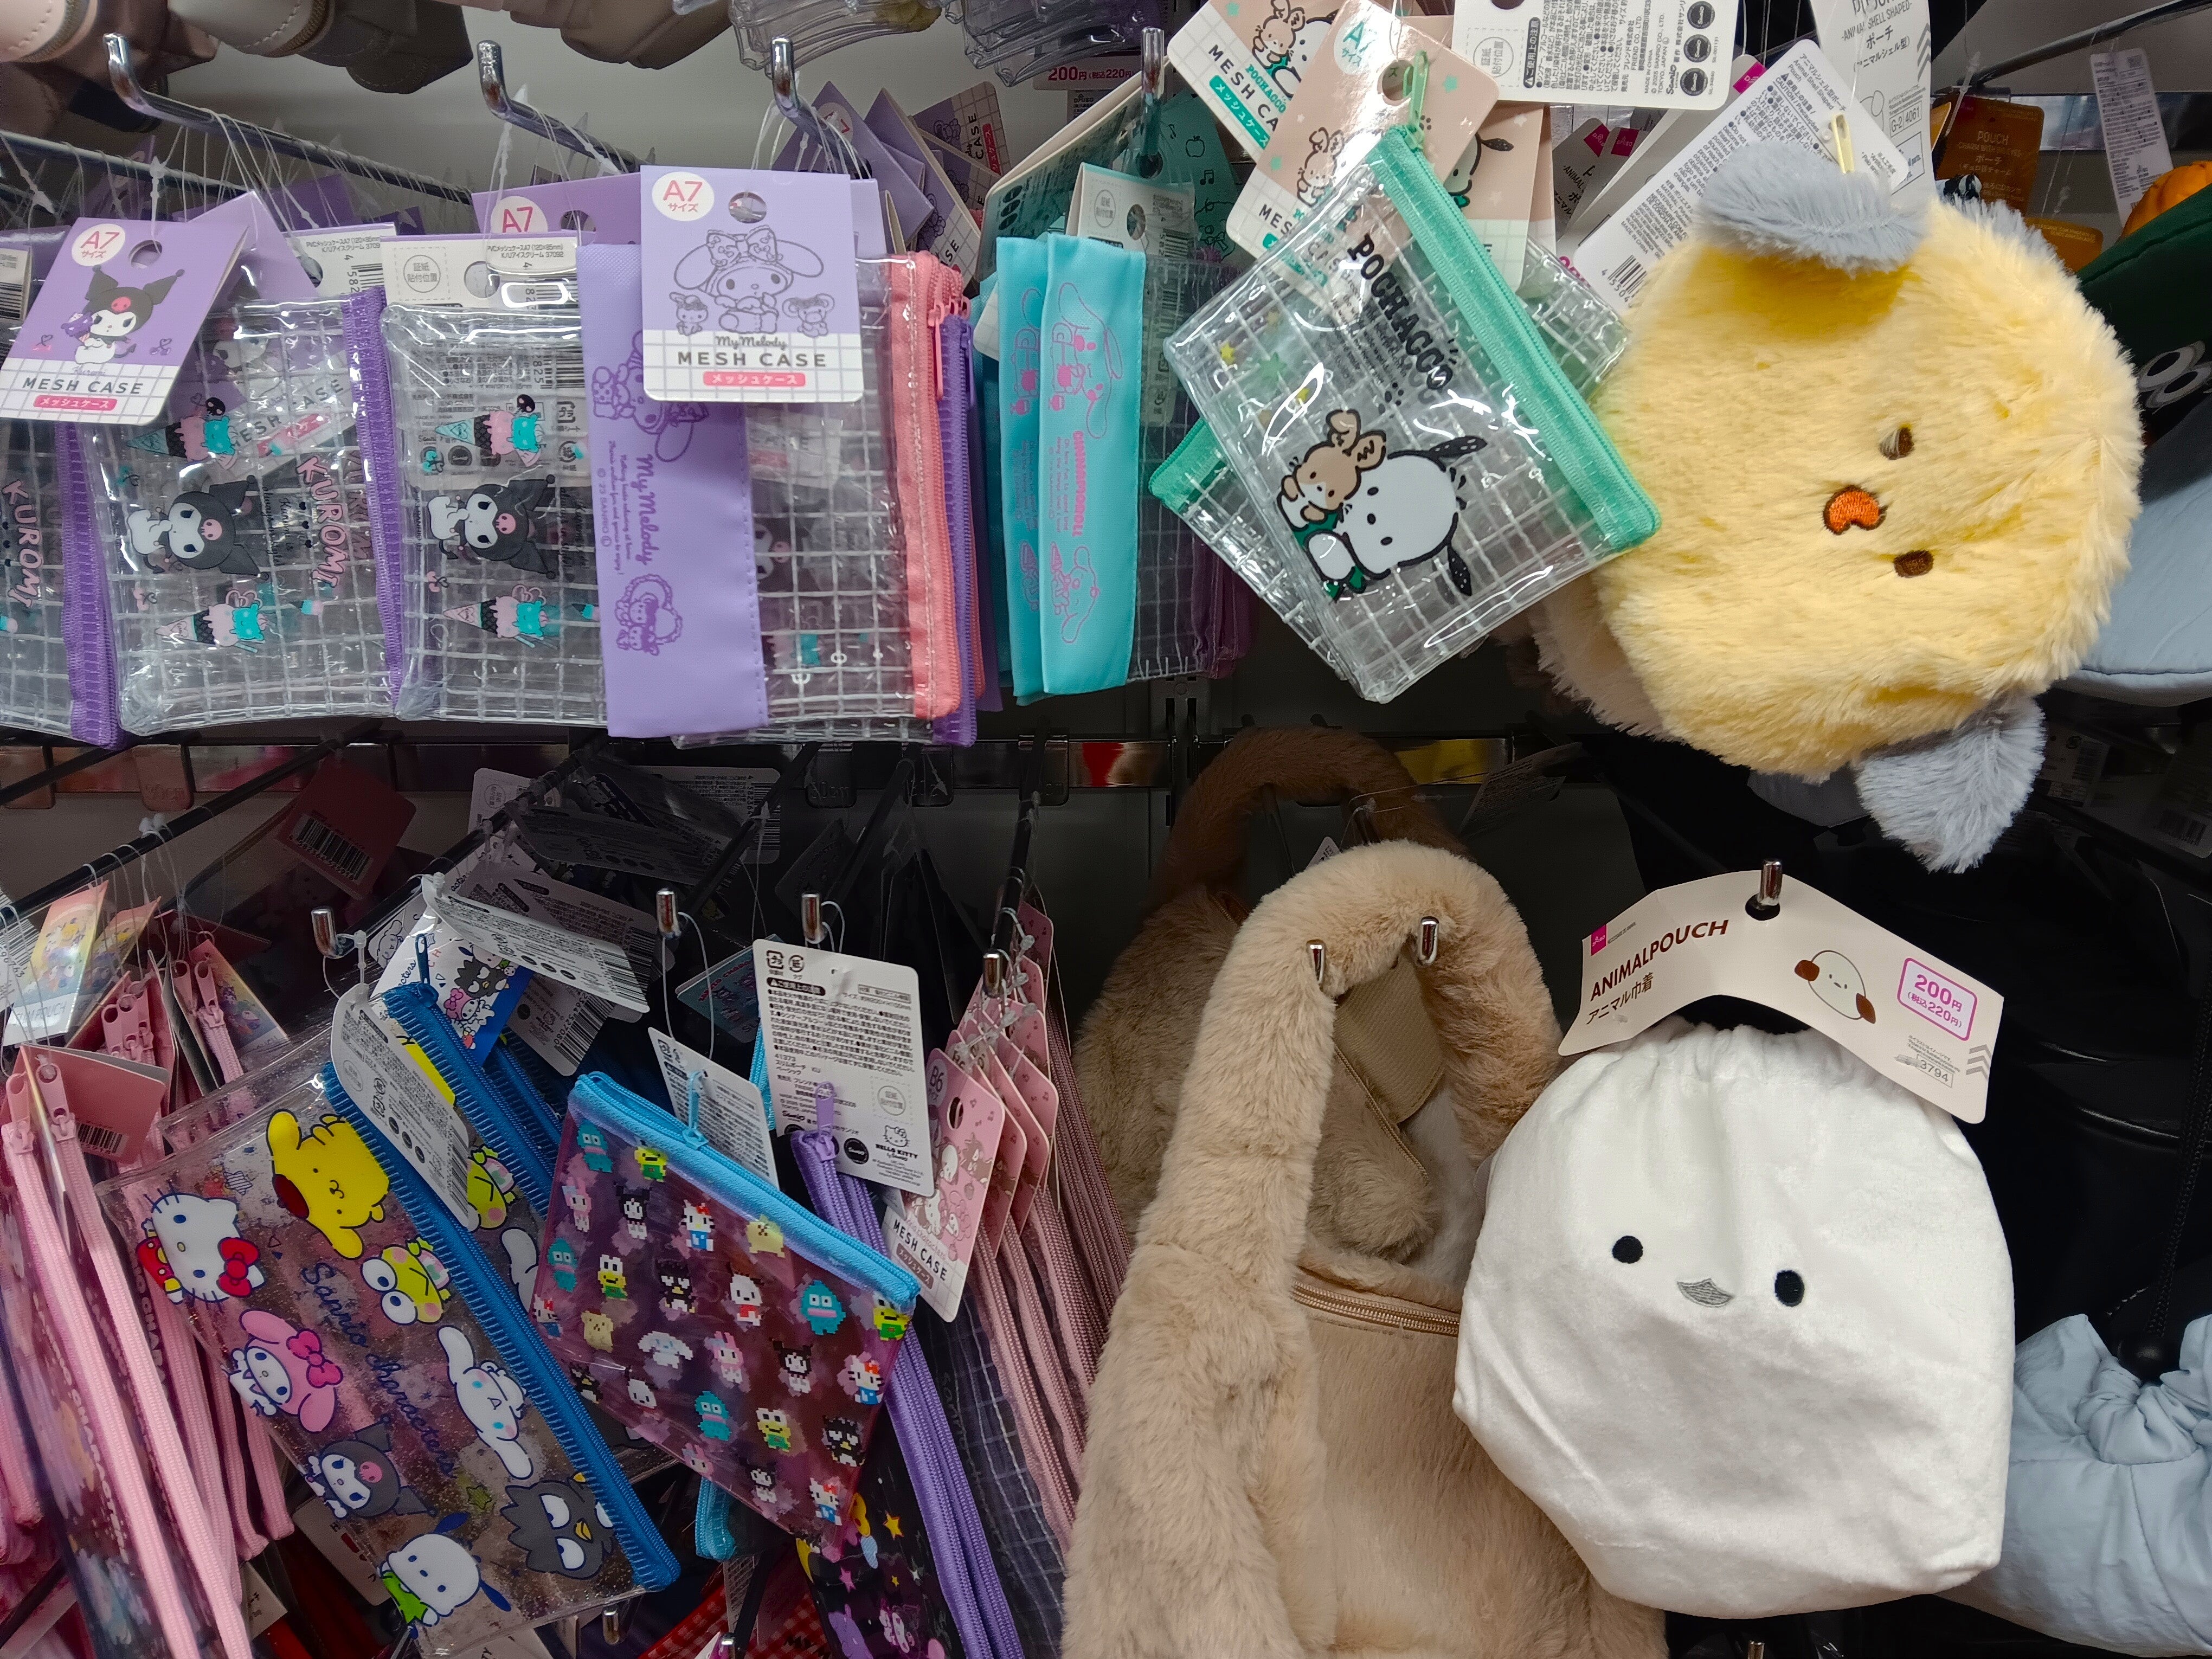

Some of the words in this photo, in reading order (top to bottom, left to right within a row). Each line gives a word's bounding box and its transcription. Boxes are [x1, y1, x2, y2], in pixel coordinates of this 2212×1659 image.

[1526, 20, 1539, 76] ご使用上の注意
[1863, 24, 1895, 49] ポーチ
[1631, 46, 1639, 70] FRIEND
[1048, 66, 1087, 81] 200円
[1206, 43, 1257, 100] MESH
[1666, 63, 1677, 94] Sanrio
[1786, 63, 1804, 82] Pouch
[1244, 63, 1288, 114] POCHACCO
[1774, 76, 1796, 101] CAUTION
[1792, 59, 1809, 78] Animal
[1806, 76, 1819, 91] Shell
[1815, 88, 1835, 111] Shaped
[1214, 81, 1272, 148] メッシュケース
[1889, 116, 1904, 132] G-2
[1904, 106, 1922, 125] 4061
[968, 113, 984, 159] CASE
[1712, 135, 1730, 156] pointed
[1717, 130, 1731, 145] insert
[1722, 125, 1740, 146] become
[1737, 133, 1747, 144] not
[1977, 131, 2009, 145] POUCH
[1707, 139, 1725, 159] sources
[1707, 149, 1720, 164] reach
[1975, 154, 2002, 165] ポーチ
[1682, 162, 1695, 176] fogo
[1687, 158, 1705, 177] objetos
[1691, 153, 1711, 175] objetos
[663, 180, 703, 202] A7
[1677, 166, 1688, 178] não
[1689, 181, 1698, 191] um
[501, 205, 534, 234] A7
[667, 202, 698, 213] サイズ
[1645, 196, 1654, 205] DE
[1651, 203, 1670, 224] CONCHA
[1667, 222, 1675, 231] DE
[1649, 192, 1675, 222] NECESSAIRE
[1672, 220, 1684, 233] COM
[80, 231, 120, 250] A7
[1620, 221, 1633, 235] MADE
[1635, 239, 1649, 254] CHINA
[81, 249, 106, 261] サイズ
[1345, 232, 1457, 394] POCHACCO
[715, 335, 739, 349] My
[739, 336, 788, 350] Melody
[677, 351, 747, 366] MESH
[759, 353, 827, 367] CASE
[22, 378, 80, 392] MESH
[87, 381, 145, 395] CASE
[711, 374, 799, 385] メッシュケース
[39, 397, 110, 409] メッシュケース
[628, 453, 655, 493] My
[295, 455, 349, 588] KUROMI
[600, 497, 609, 533] SANRIO
[631, 491, 660, 566] Melody
[3, 479, 43, 611] KUROMI
[1590, 918, 1729, 1002] ANIMALPOUCH
[1586, 972, 1654, 1025] アニマル巾着
[1914, 974, 1963, 1012] 200円
[1906, 992, 1963, 1029] (税込220円)
[929, 1065, 944, 1094] B6
[1919, 1058, 1949, 1083] 3794
[782, 1110, 805, 1121] Sanrio
[875, 1143, 896, 1153] HELLO
[896, 1149, 918, 1159] KITTY
[888, 1218, 923, 1252] MESH
[915, 1247, 951, 1282] CASE
[301, 1262, 368, 1349] Sanrio
[364, 1351, 455, 1478] characters
